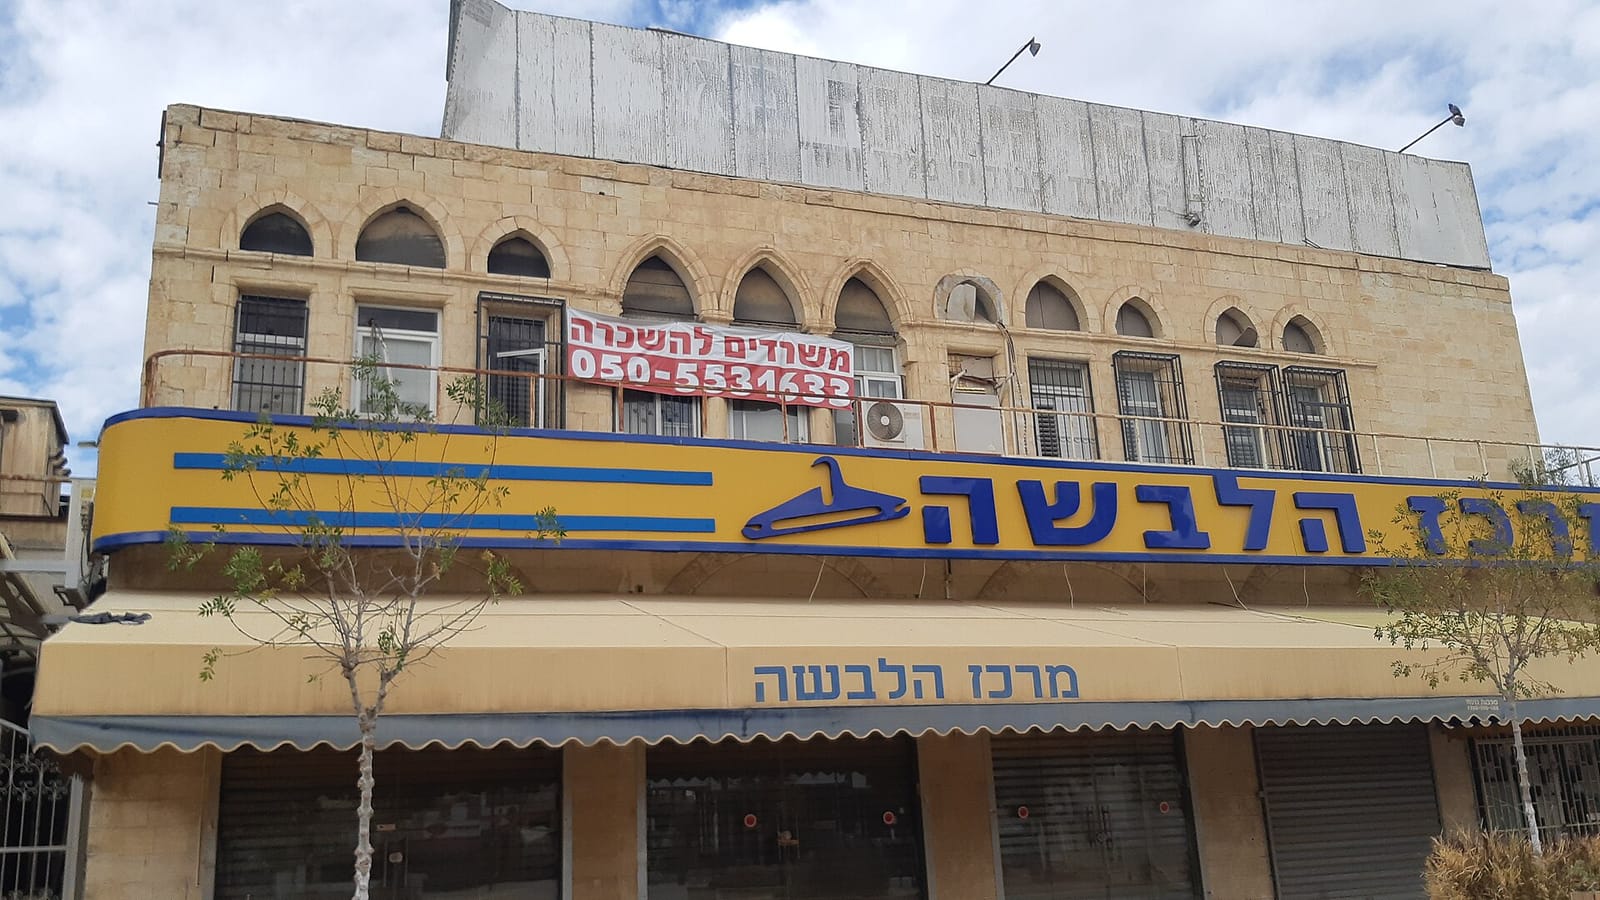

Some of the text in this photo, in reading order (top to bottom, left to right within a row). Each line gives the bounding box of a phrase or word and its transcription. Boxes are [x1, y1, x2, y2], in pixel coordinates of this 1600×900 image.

[570, 316, 850, 373] משרדים להשכרה
[570, 348, 851, 408] 050-5531633
[919, 474, 1366, 554] הלבשה
[754, 657, 1080, 703] מרכז הלבשה
